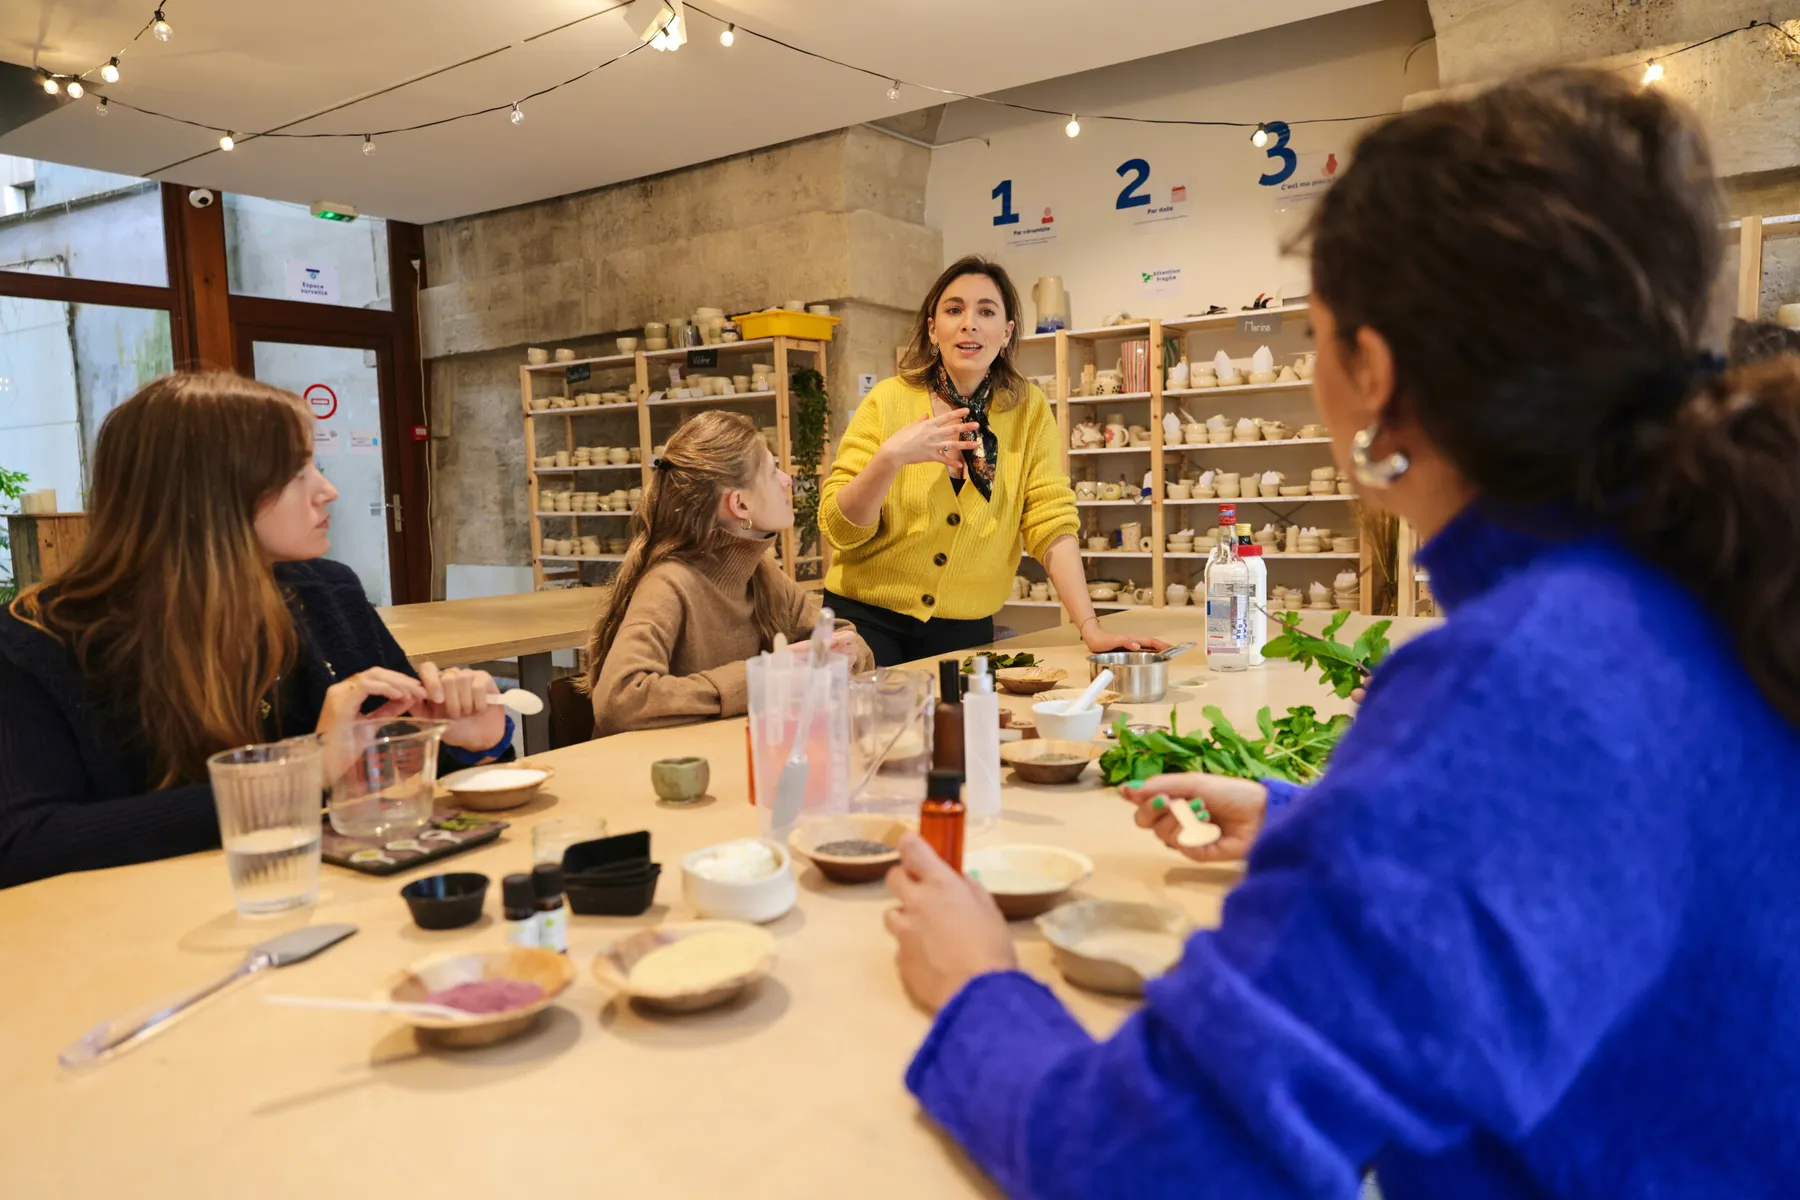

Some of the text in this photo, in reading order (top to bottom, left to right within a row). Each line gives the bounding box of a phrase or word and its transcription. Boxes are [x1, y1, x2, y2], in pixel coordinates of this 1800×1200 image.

[1250, 121, 1297, 186] 3
[991, 179, 1020, 226] 1
[1115, 158, 1151, 210] 2
